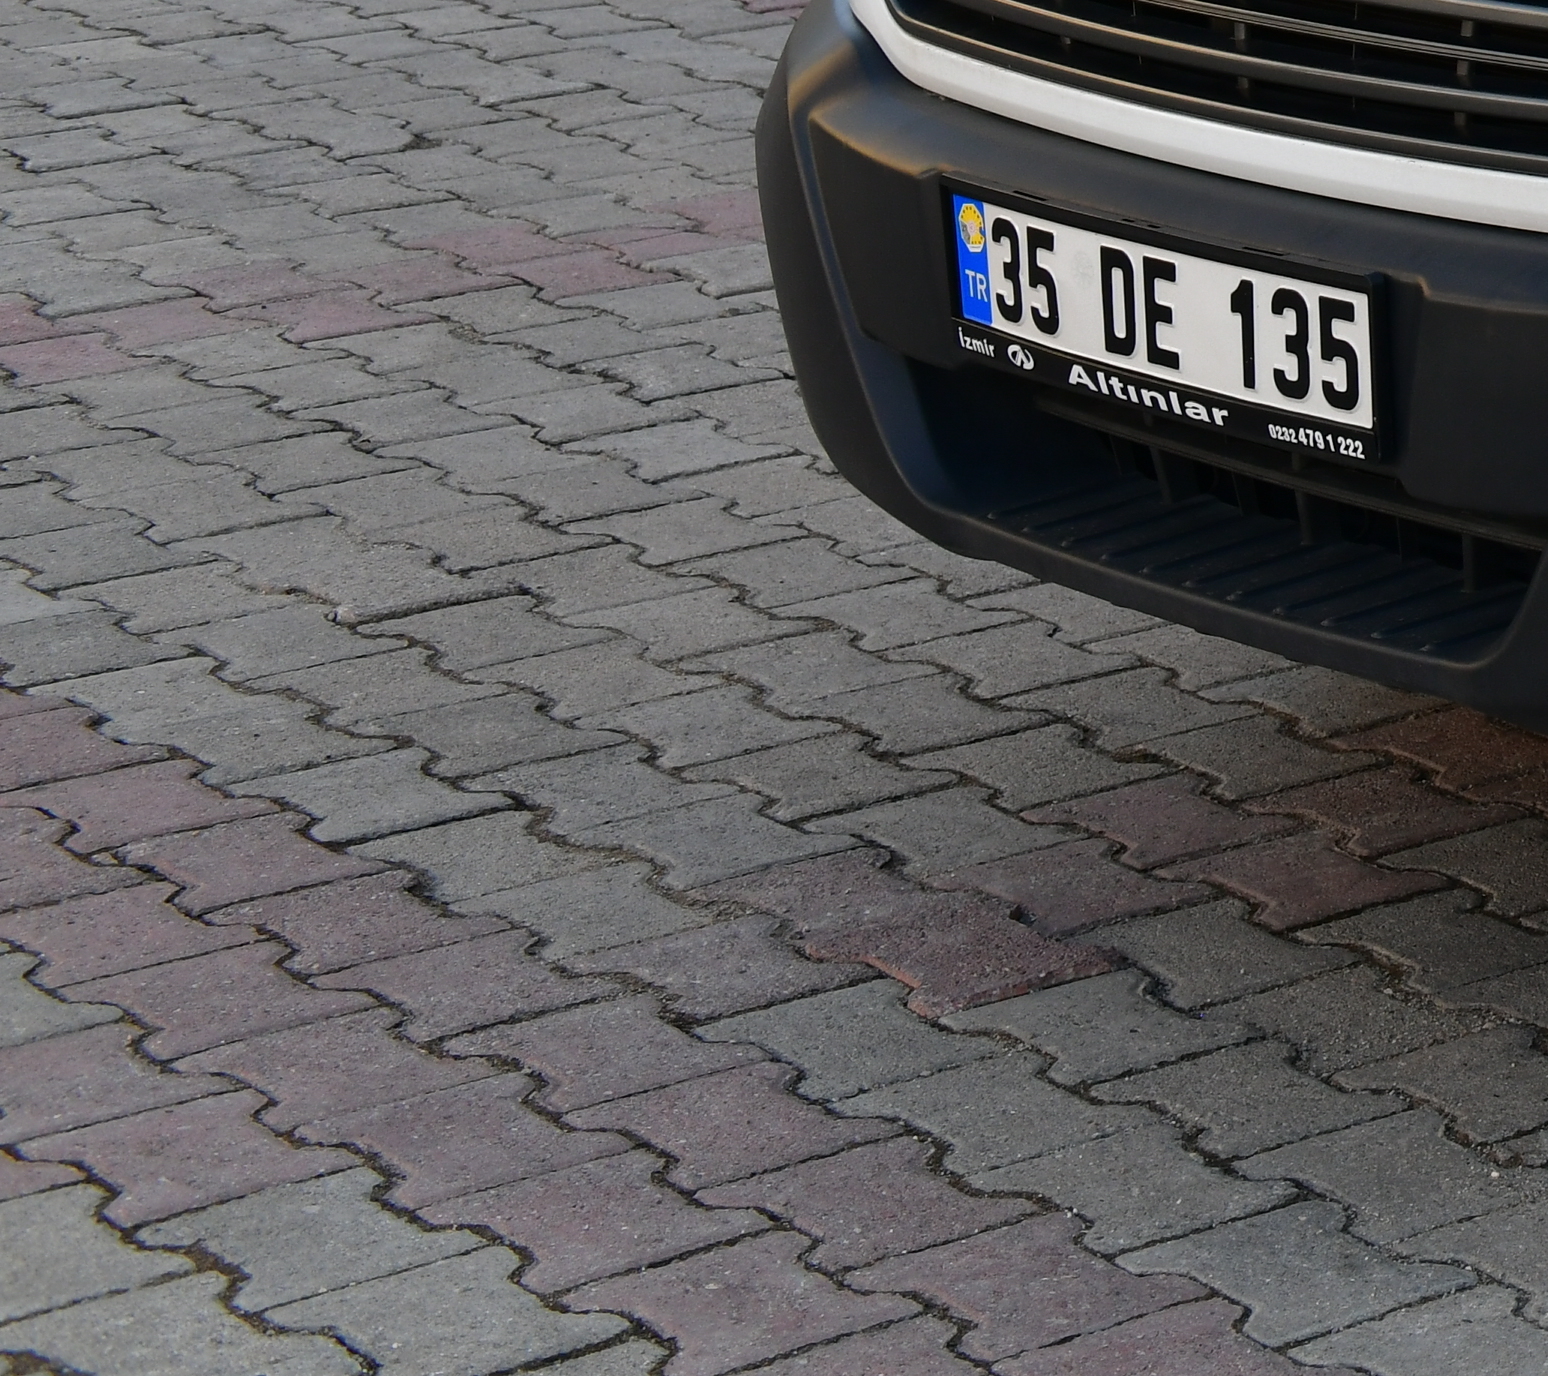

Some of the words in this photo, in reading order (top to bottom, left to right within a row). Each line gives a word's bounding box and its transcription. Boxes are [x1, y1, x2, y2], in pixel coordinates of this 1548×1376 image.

[964, 268, 988, 302] TR
[991, 216, 1060, 337] 35
[1099, 245, 1180, 370] DE
[1230, 279, 1360, 411] 135
[957, 327, 997, 359] İzmir
[1068, 364, 1229, 428] Altınlar
